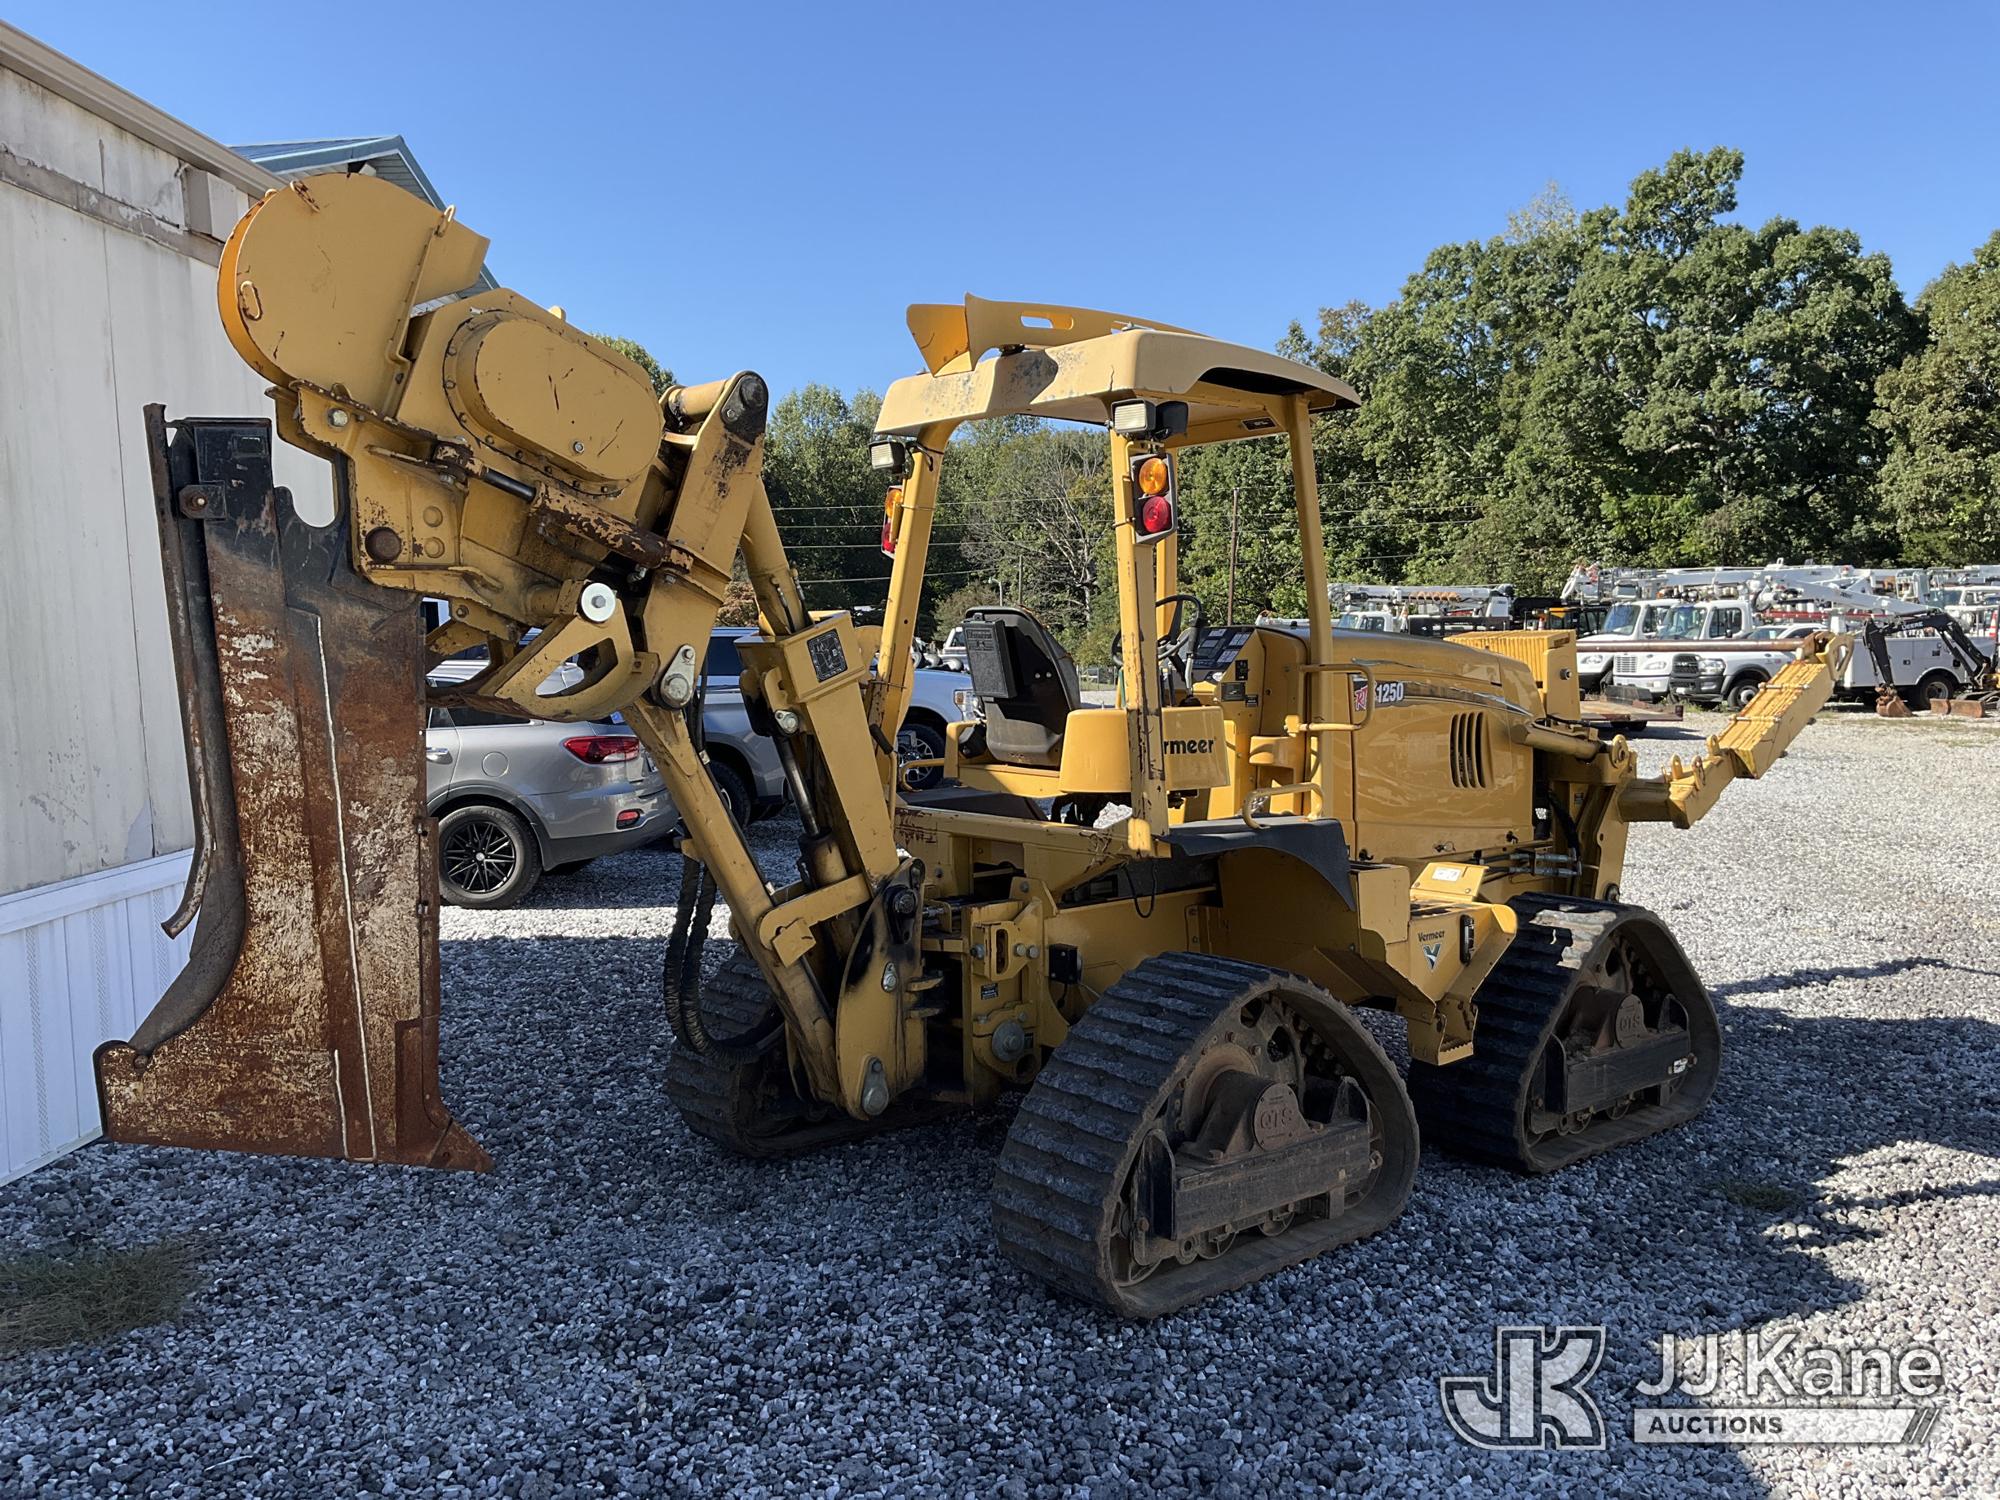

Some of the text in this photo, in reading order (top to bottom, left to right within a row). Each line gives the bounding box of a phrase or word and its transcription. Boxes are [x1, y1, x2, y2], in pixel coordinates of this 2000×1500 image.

[1376, 681, 1404, 703] 1250
[1163, 739, 1214, 755] rmeer
[1417, 930, 1445, 942] Vermeer
